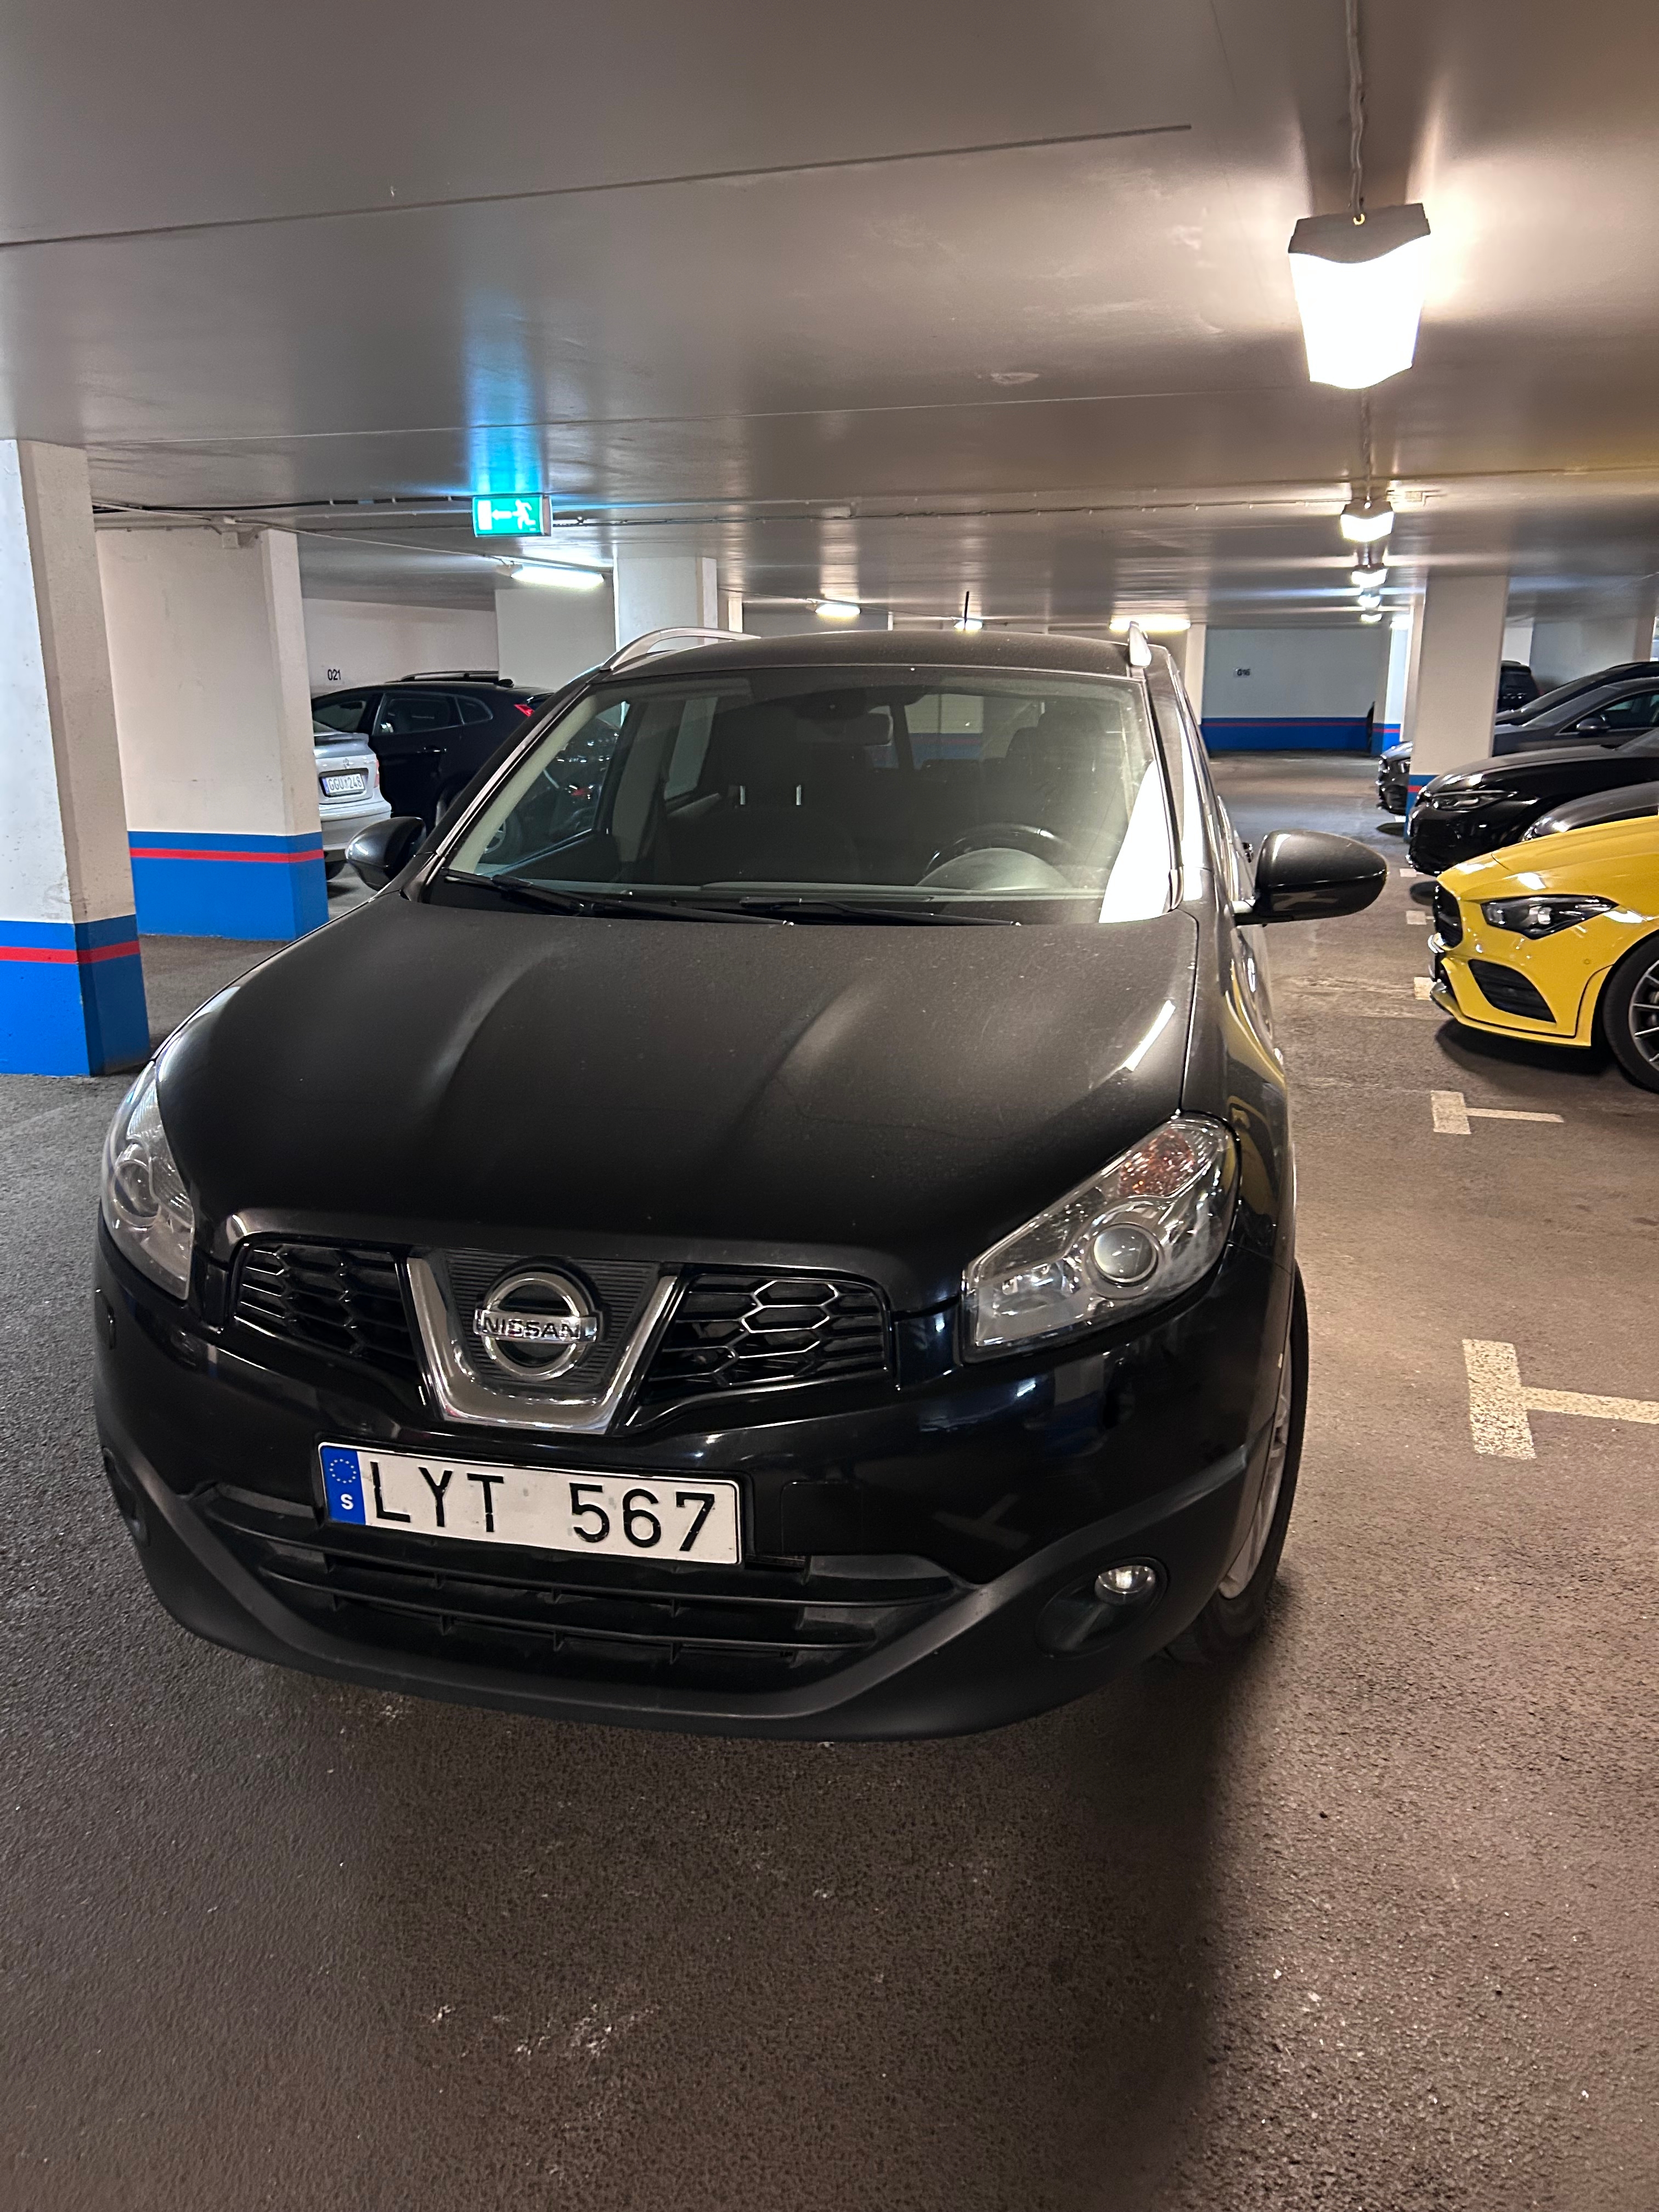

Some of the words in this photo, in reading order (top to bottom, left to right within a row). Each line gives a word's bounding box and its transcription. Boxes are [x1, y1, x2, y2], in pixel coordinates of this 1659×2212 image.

[328, 669, 341, 680] 021
[329, 778, 344, 791] GGU
[348, 776, 362, 789] 248
[483, 1317, 580, 1339] NISSAN
[340, 1494, 354, 1510] S
[370, 1462, 505, 1532] LYT
[569, 1482, 715, 1551] 567
